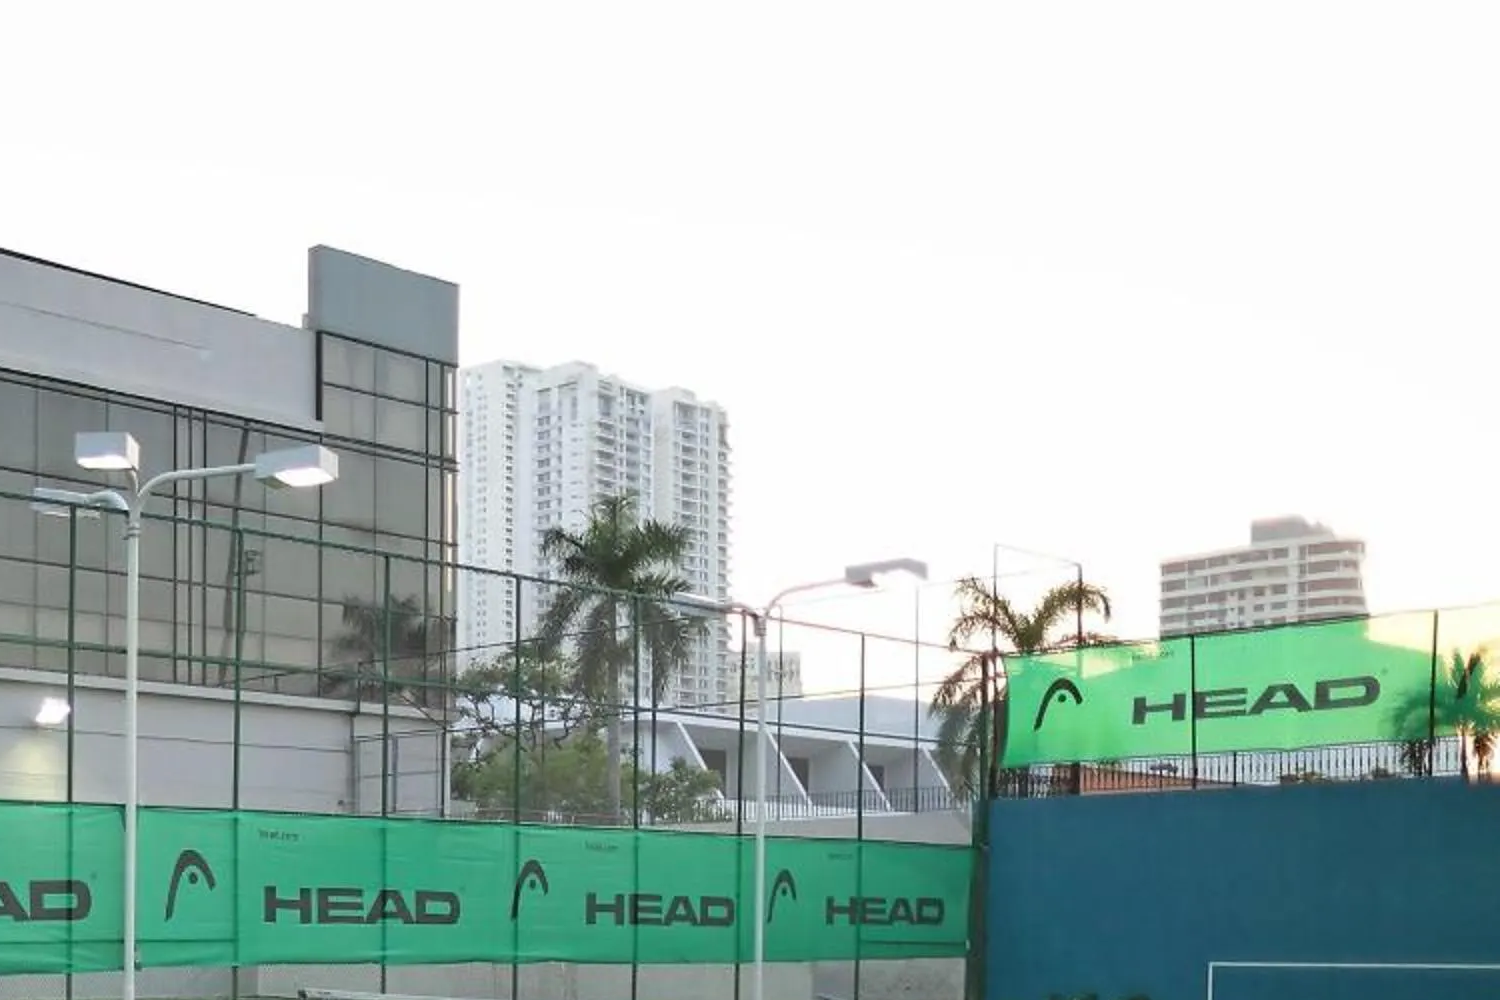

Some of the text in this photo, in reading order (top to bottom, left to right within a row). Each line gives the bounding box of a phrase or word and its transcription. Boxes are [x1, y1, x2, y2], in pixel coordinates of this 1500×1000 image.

[1132, 675, 1381, 725] HEAD
[264, 886, 460, 924] HEAD
[585, 892, 735, 927] HEAD
[825, 896, 945, 925] HEAD
